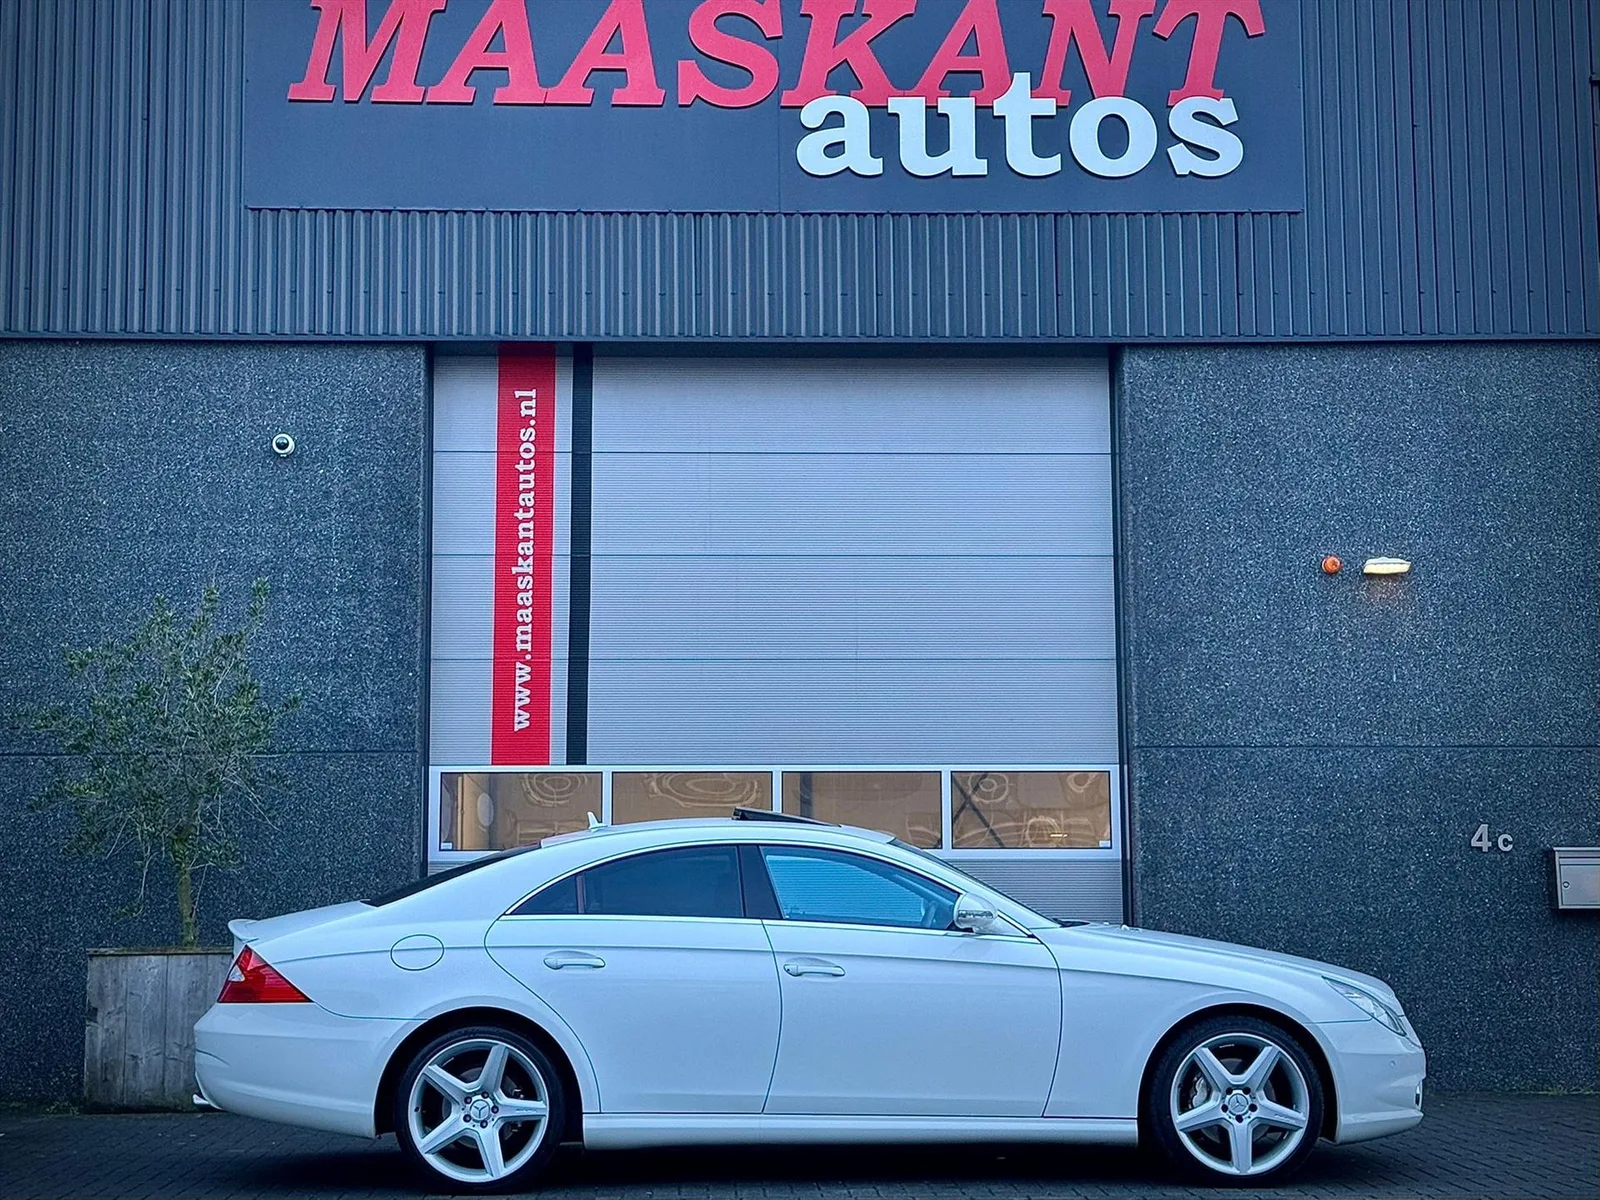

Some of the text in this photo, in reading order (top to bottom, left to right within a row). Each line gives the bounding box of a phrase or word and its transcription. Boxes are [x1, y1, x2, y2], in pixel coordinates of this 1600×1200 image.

[287, 0, 1266, 107] MAASKANT
[796, 71, 1244, 177] autos
[511, 388, 537, 732] www.maaskantautos.nl
